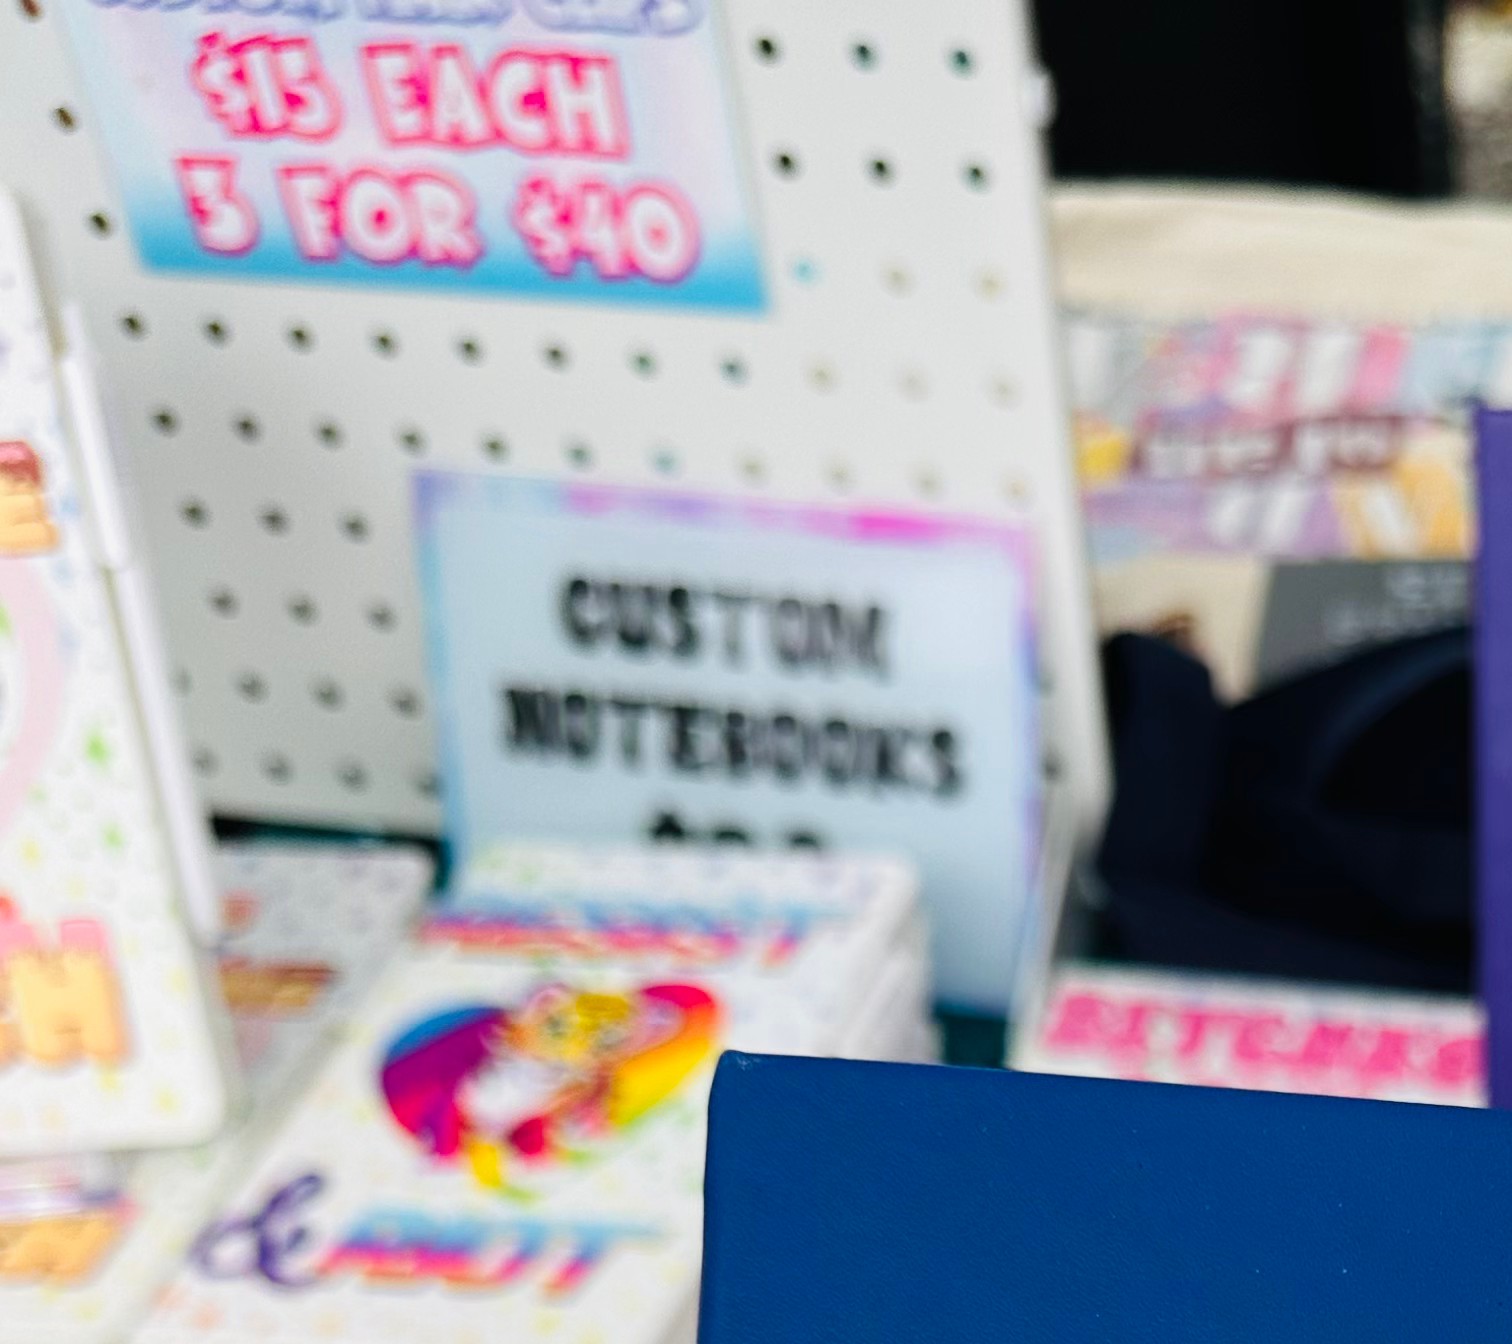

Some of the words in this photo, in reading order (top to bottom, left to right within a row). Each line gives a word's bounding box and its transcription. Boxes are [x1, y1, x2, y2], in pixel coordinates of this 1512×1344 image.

[191, 30, 344, 142] $15
[359, 43, 630, 161] EACH
[173, 156, 259, 256] 3
[277, 162, 484, 270] FOR
[512, 176, 703, 285] $40
[561, 577, 895, 676] CUSTOM
[500, 683, 966, 796] NOTEBOOKS
